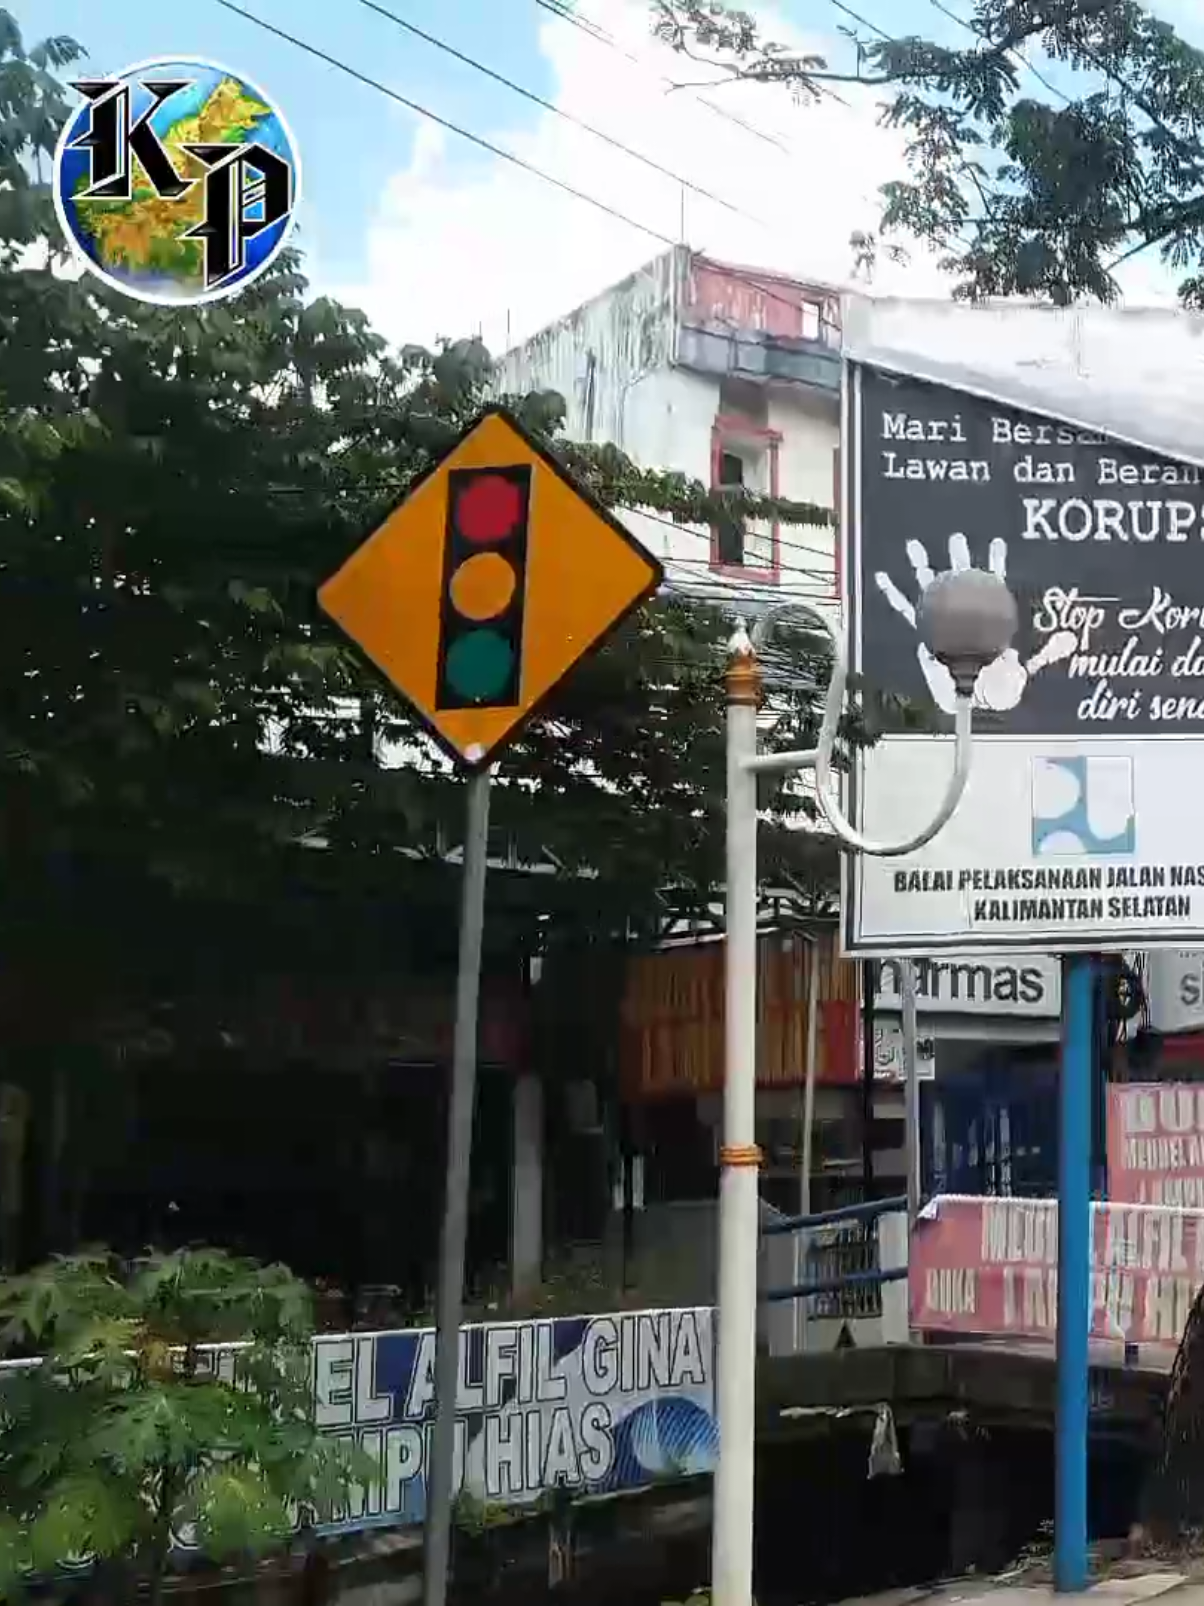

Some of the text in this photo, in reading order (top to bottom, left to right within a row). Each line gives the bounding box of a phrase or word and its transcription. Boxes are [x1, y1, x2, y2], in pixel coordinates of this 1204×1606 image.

[881, 410, 967, 442] Mari
[881, 450, 991, 481] Lawan
[1013, 455, 1076, 482] dan
[1021, 498, 1204, 541] KORUP
[1033, 585, 1204, 652] Stop Kor
[1068, 635, 1164, 679] mulai
[1076, 677, 1142, 720] diri
[894, 864, 1204, 893] BALAI PELAKSANAAN JALAN NAS
[974, 896, 1191, 922] KALIMANTAN SELATAN
[582, 1307, 706, 1397] GINA
[485, 1402, 616, 1497] HIAS
